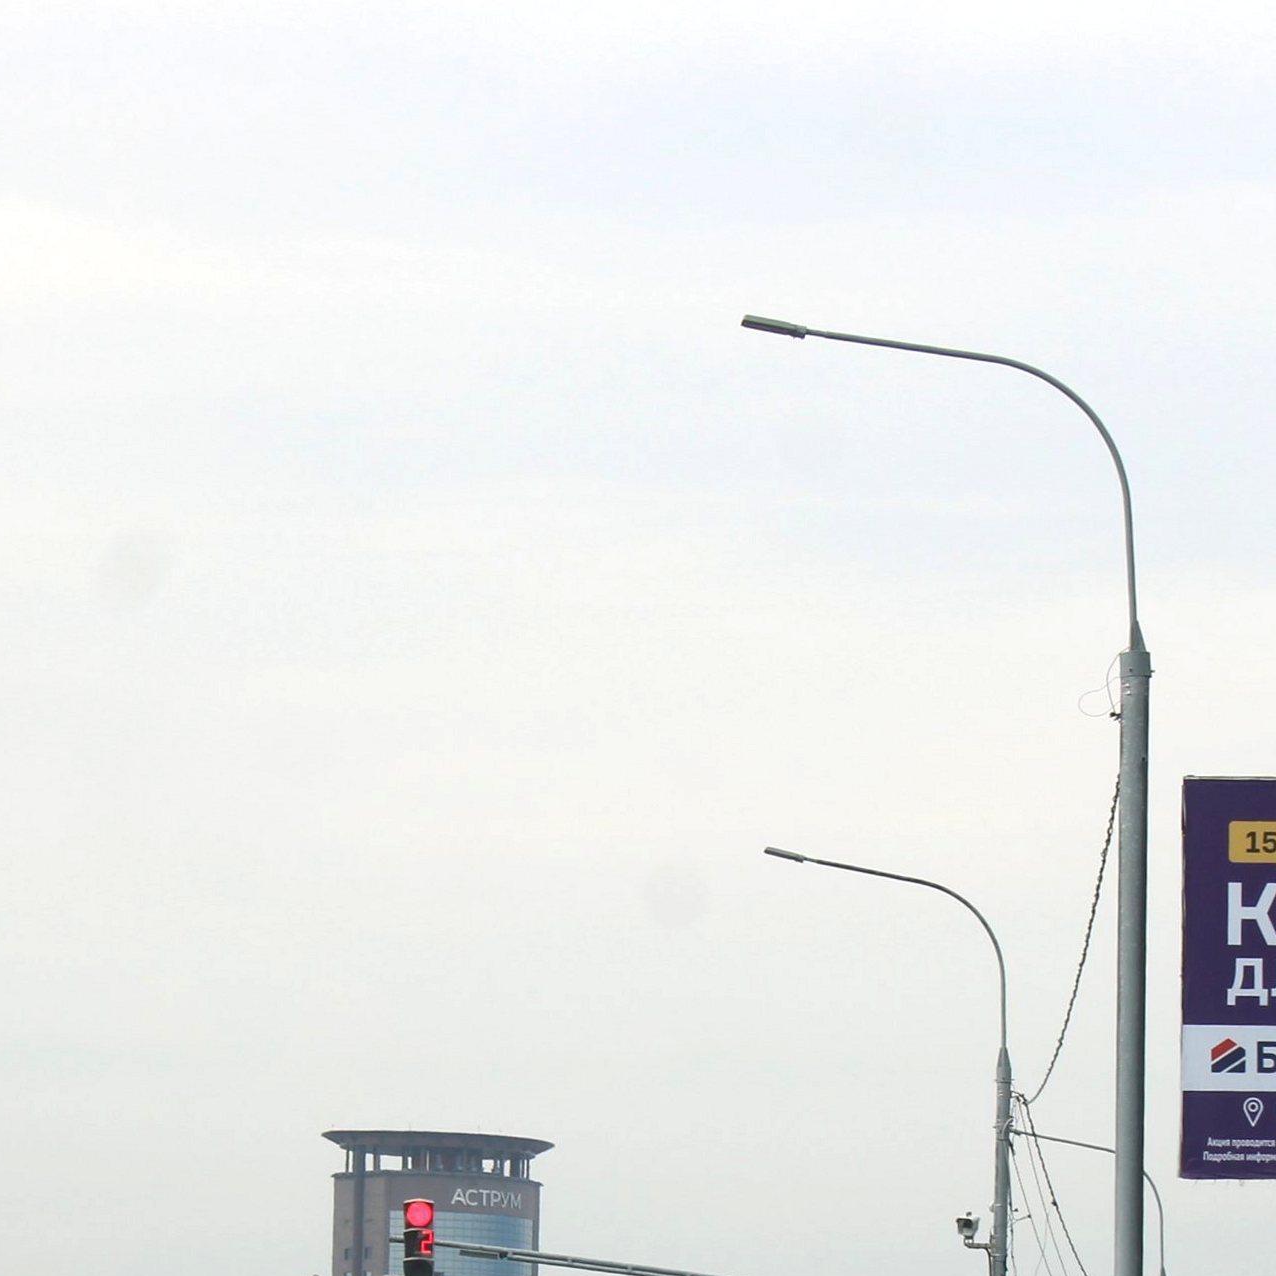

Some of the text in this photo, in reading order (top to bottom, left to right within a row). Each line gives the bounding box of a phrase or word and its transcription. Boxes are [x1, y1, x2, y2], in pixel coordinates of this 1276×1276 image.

[1207, 1137, 1231, 1148] Акция
[450, 1188, 522, 1209] АСТРУМ
[420, 1229, 434, 1255] 2
